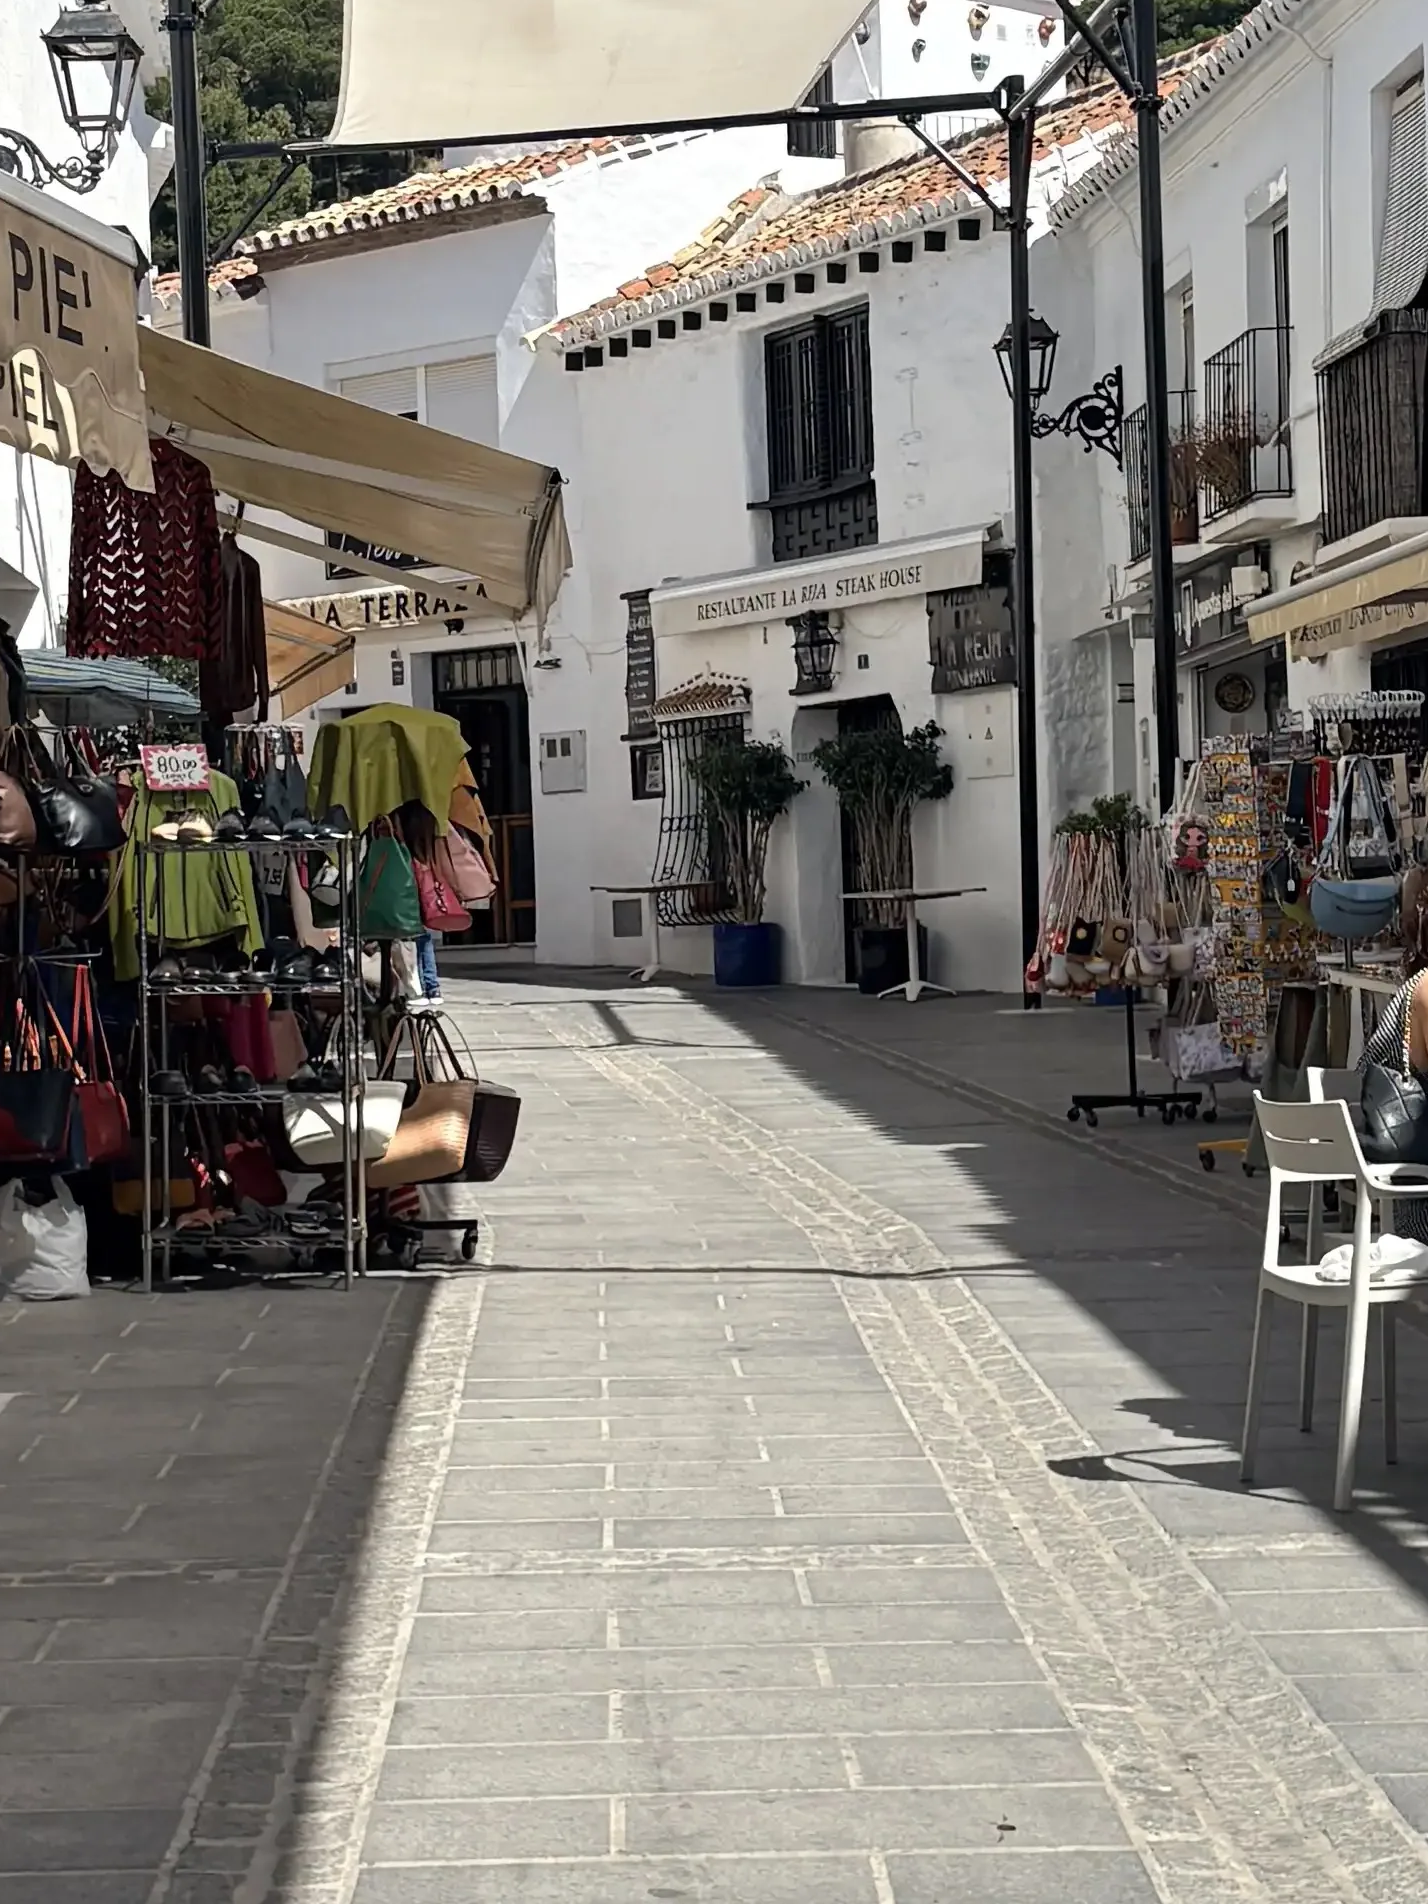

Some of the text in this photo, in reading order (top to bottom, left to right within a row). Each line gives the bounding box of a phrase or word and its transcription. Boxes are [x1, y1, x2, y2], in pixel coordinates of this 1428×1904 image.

[697, 591, 777, 621] RESTAURANTE
[782, 589, 798, 608] LA
[835, 572, 876, 597] STEAK
[879, 565, 923, 589] HOUSE
